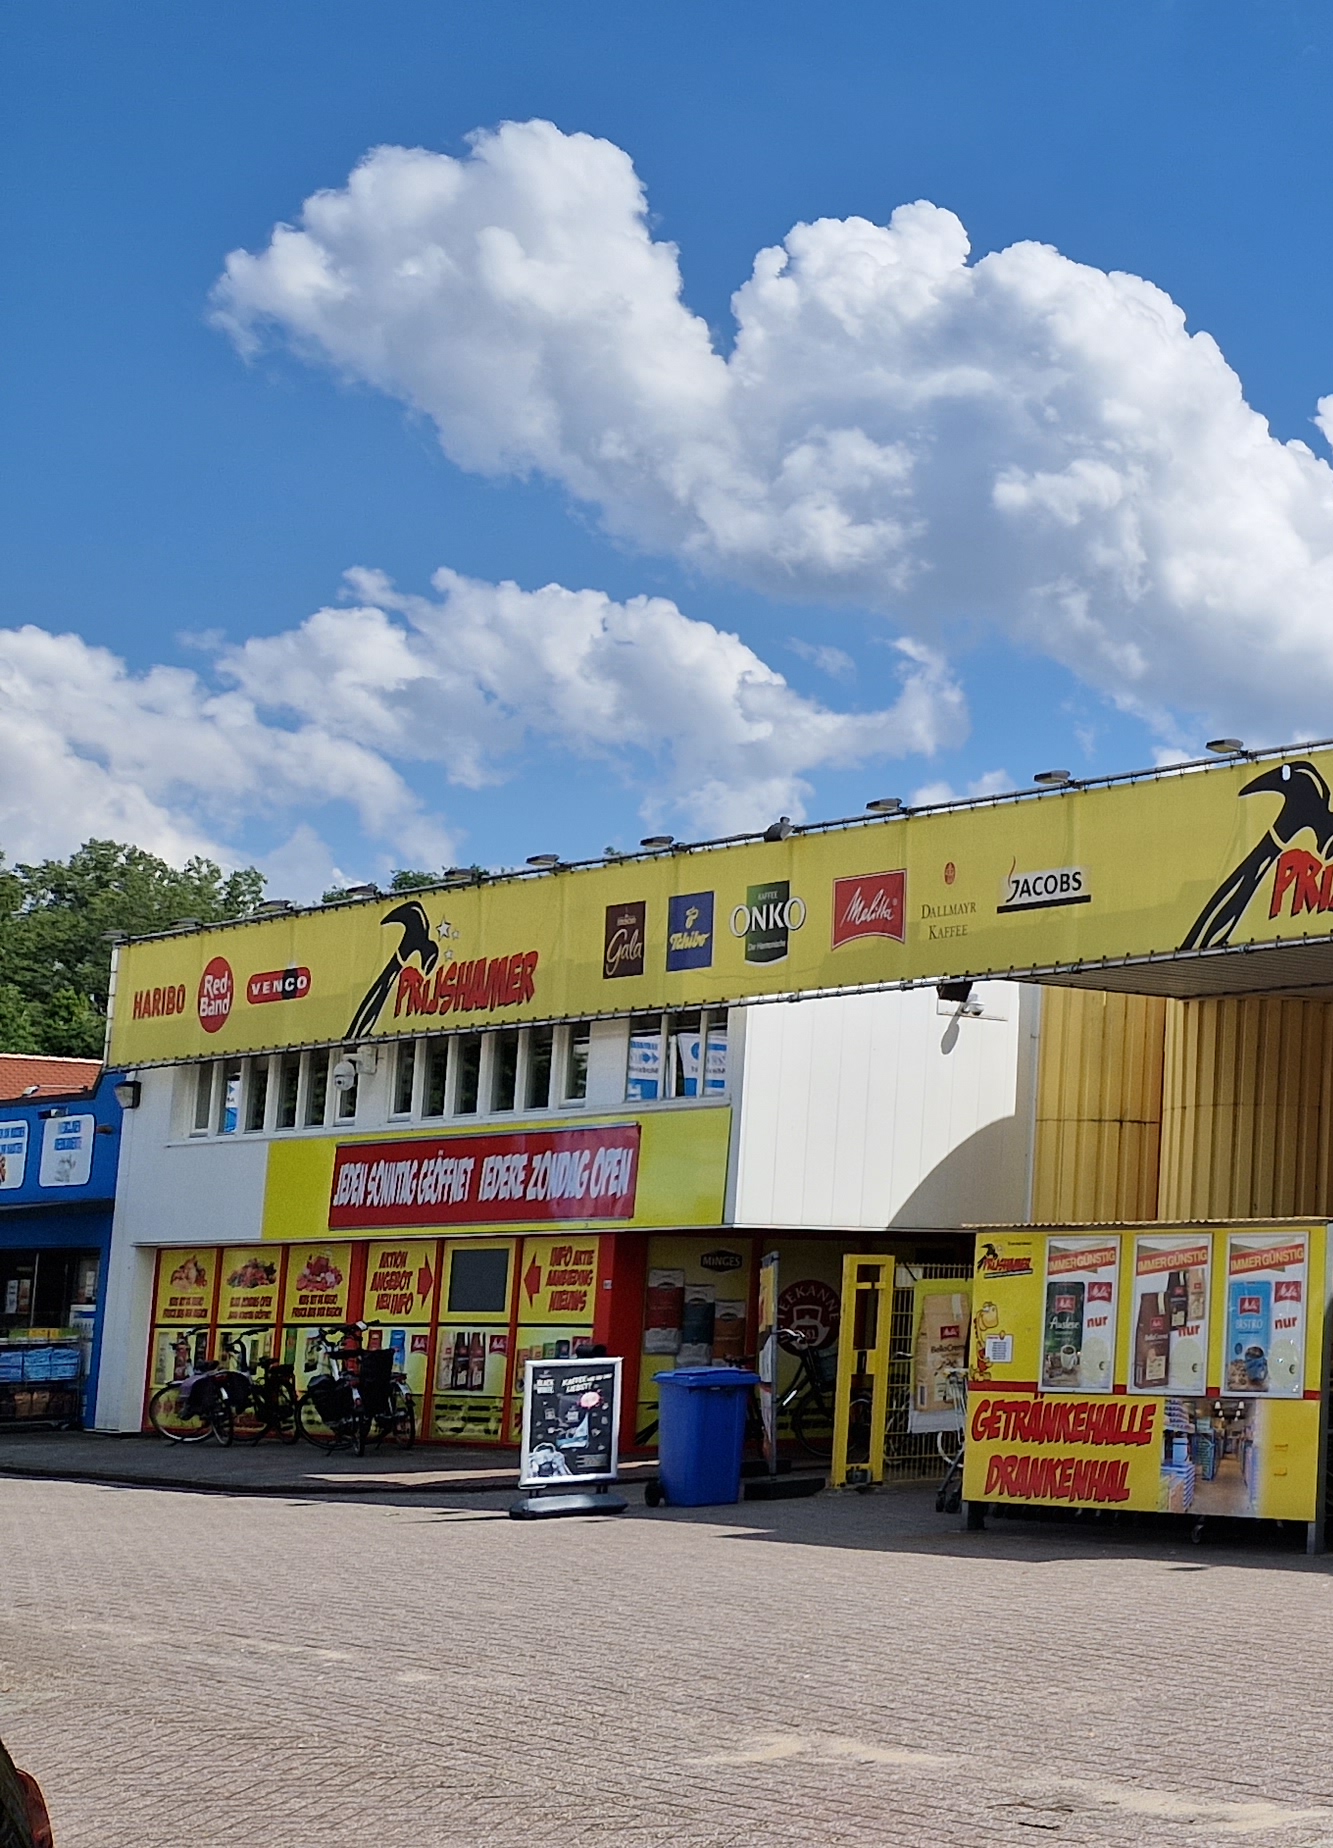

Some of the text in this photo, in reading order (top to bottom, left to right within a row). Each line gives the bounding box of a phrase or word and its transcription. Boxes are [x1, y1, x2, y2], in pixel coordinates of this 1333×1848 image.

[757, 891, 778, 900] KAFFEE
[1006, 872, 1082, 903] JACOBS
[730, 896, 806, 938] ONKO
[840, 886, 895, 928] Melitta
[921, 902, 977, 919] DALLMAYR
[670, 931, 711, 951] Tchibo
[928, 925, 968, 940] KAFFEE
[606, 929, 642, 975] Gala
[251, 976, 308, 996] VENCO
[393, 951, 538, 1018] PRIJSHAMER
[133, 984, 186, 1020] HARIBO
[200, 996, 230, 1017] Band
[333, 1147, 634, 1207] JEDEN SONNTAG GEÖFFNET IEDERE ZONDAG OPEN
[379, 1251, 408, 1269] AKTION
[550, 1245, 573, 1267] INFO
[702, 1256, 741, 1267] MINGES
[370, 1271, 413, 1291] ANGEBOT
[375, 1291, 414, 1315] NEU INFO
[548, 1290, 587, 1312] NIEUWS
[1049, 1316, 1079, 1330] Auslese
[1087, 1315, 1108, 1329] nur
[1178, 1325, 1200, 1337] nur
[1274, 1317, 1298, 1330] nur
[1191, 1363, 1198, 1373] €
[1289, 1364, 1295, 1374] €
[971, 1392, 1156, 1447] GETRÄNKEHALLE
[984, 1454, 1131, 1503] DRANKENHAL
